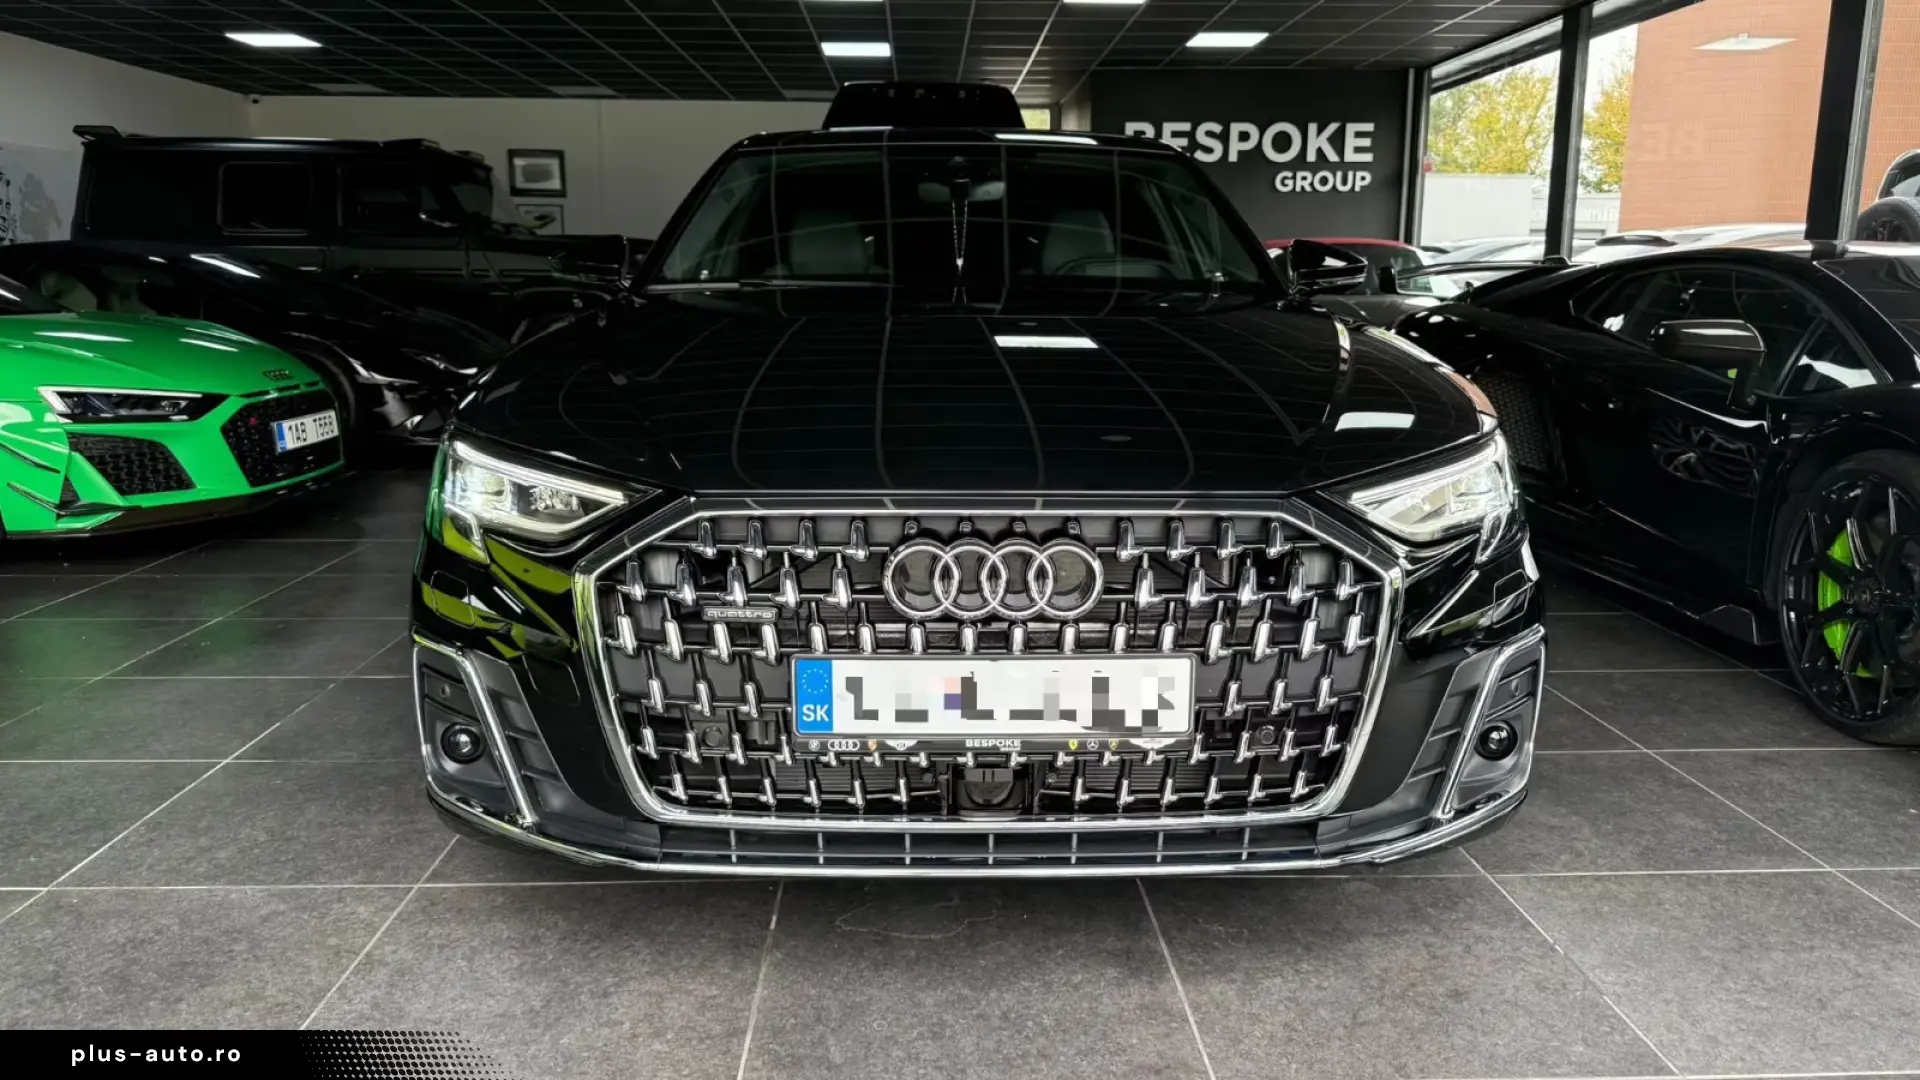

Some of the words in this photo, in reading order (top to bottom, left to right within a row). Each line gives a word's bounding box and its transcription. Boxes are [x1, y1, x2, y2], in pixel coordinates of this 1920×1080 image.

[1274, 171, 1371, 192] GROUP
[707, 610, 773, 619] quattro
[802, 703, 830, 722] SK
